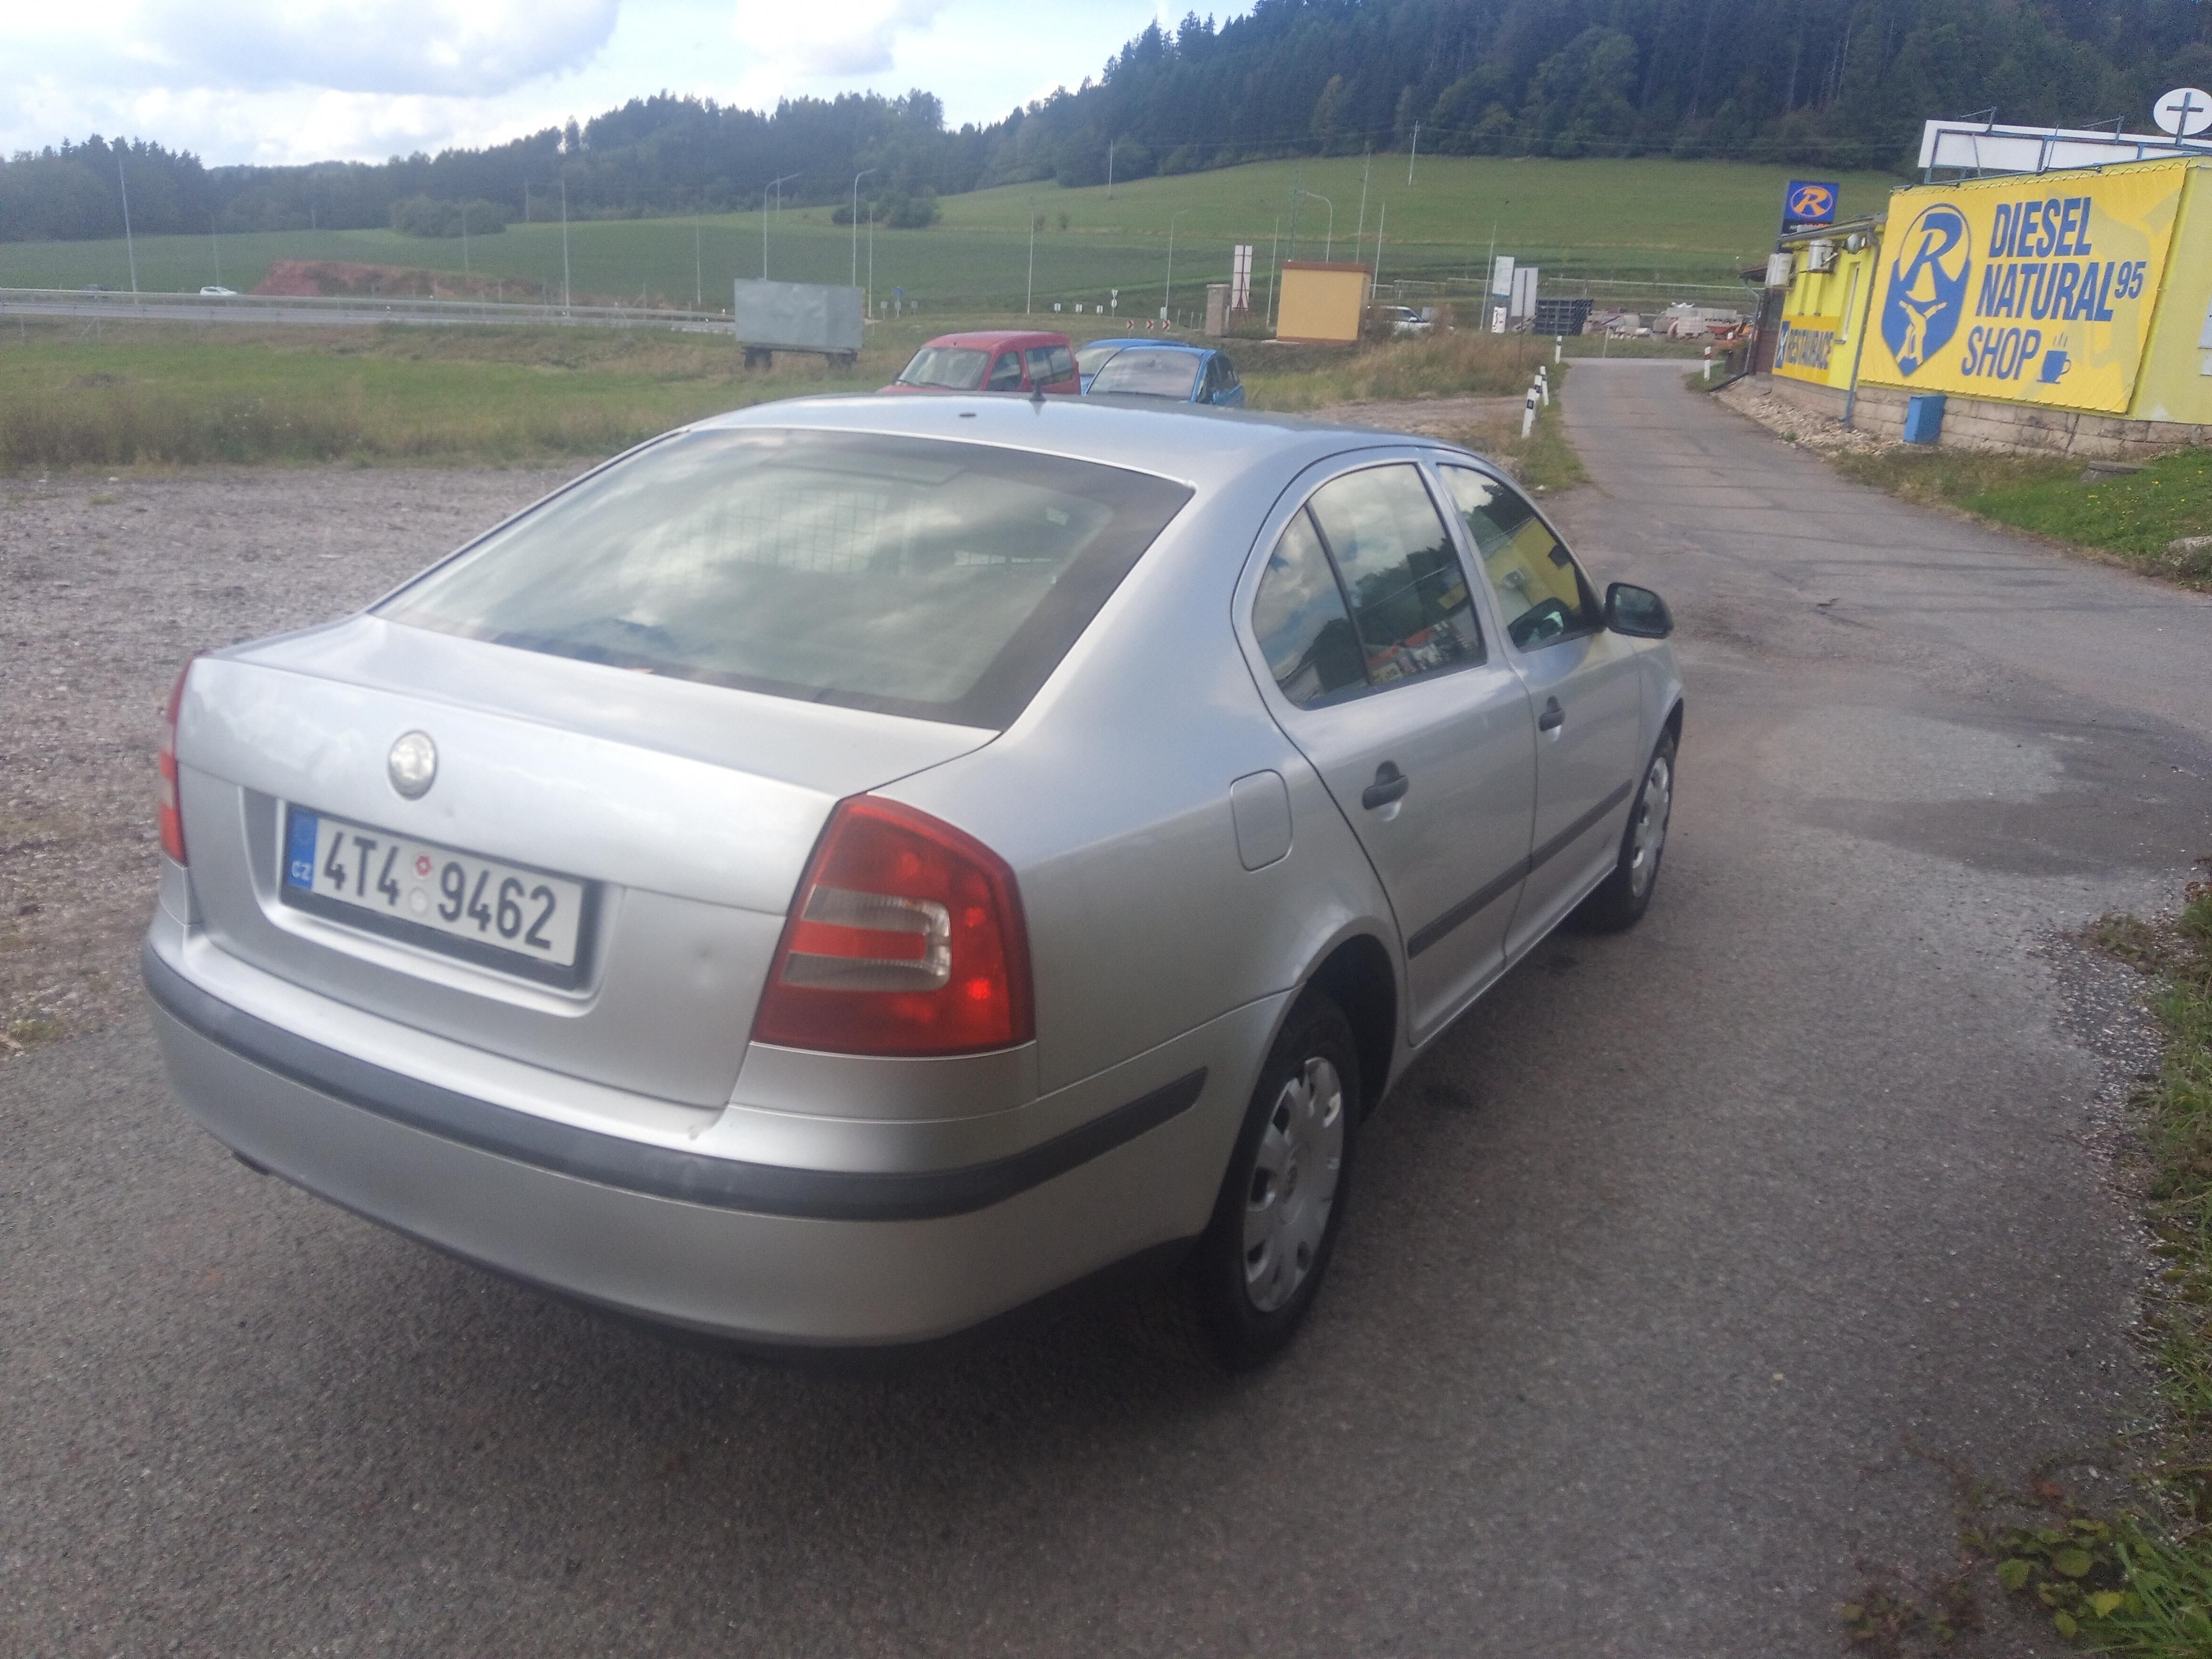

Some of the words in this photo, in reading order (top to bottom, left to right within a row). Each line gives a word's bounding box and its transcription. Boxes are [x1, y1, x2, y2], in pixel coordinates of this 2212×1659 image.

[1988, 197, 2092, 258] DIESEL
[1975, 261, 2116, 322] NATURAL
[2114, 261, 2147, 299] 95
[1961, 325, 2042, 381] SHOP
[324, 831, 400, 906] 4T4
[437, 860, 557, 951] 9462
